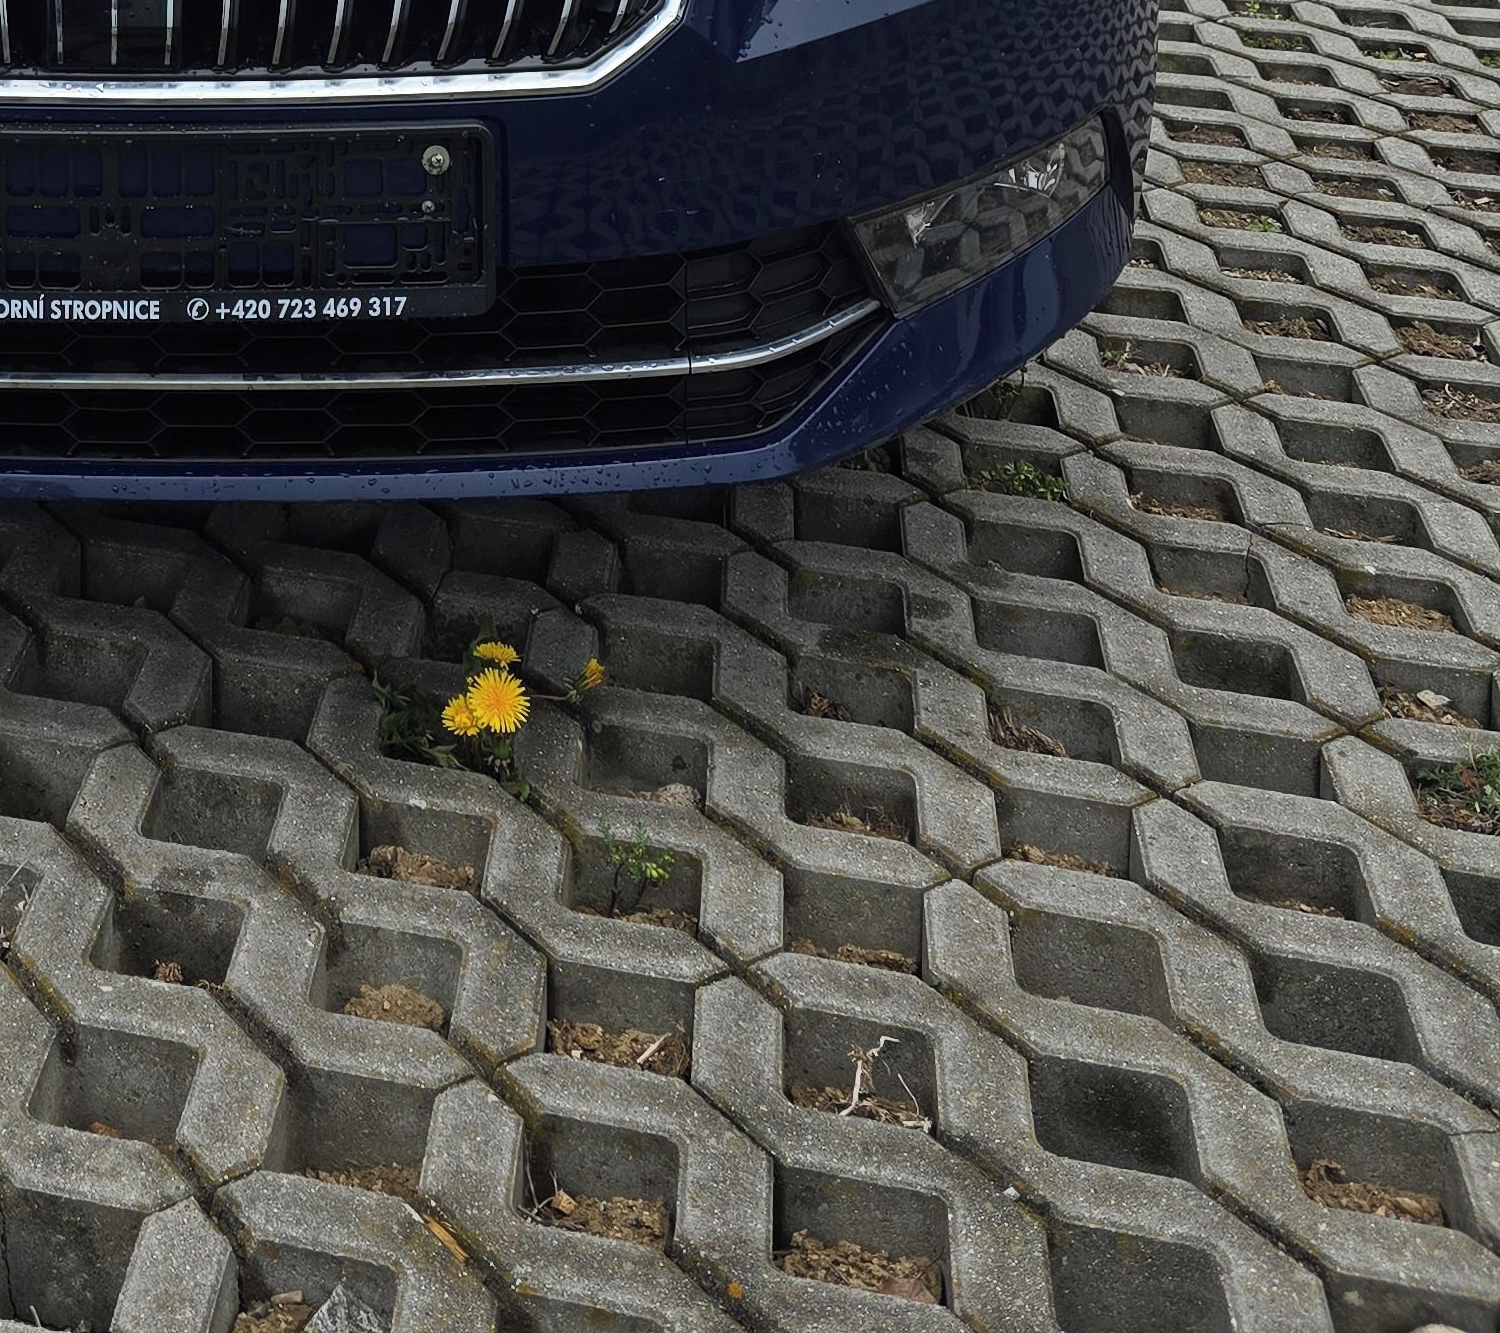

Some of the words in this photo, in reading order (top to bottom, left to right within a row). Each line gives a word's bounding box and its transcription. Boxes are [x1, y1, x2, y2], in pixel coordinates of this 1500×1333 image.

[50, 298, 161, 321] STROPNICE
[215, 298, 272, 320] +420
[277, 298, 317, 320] 723
[322, 296, 362, 318] 469
[368, 295, 408, 317] 317
